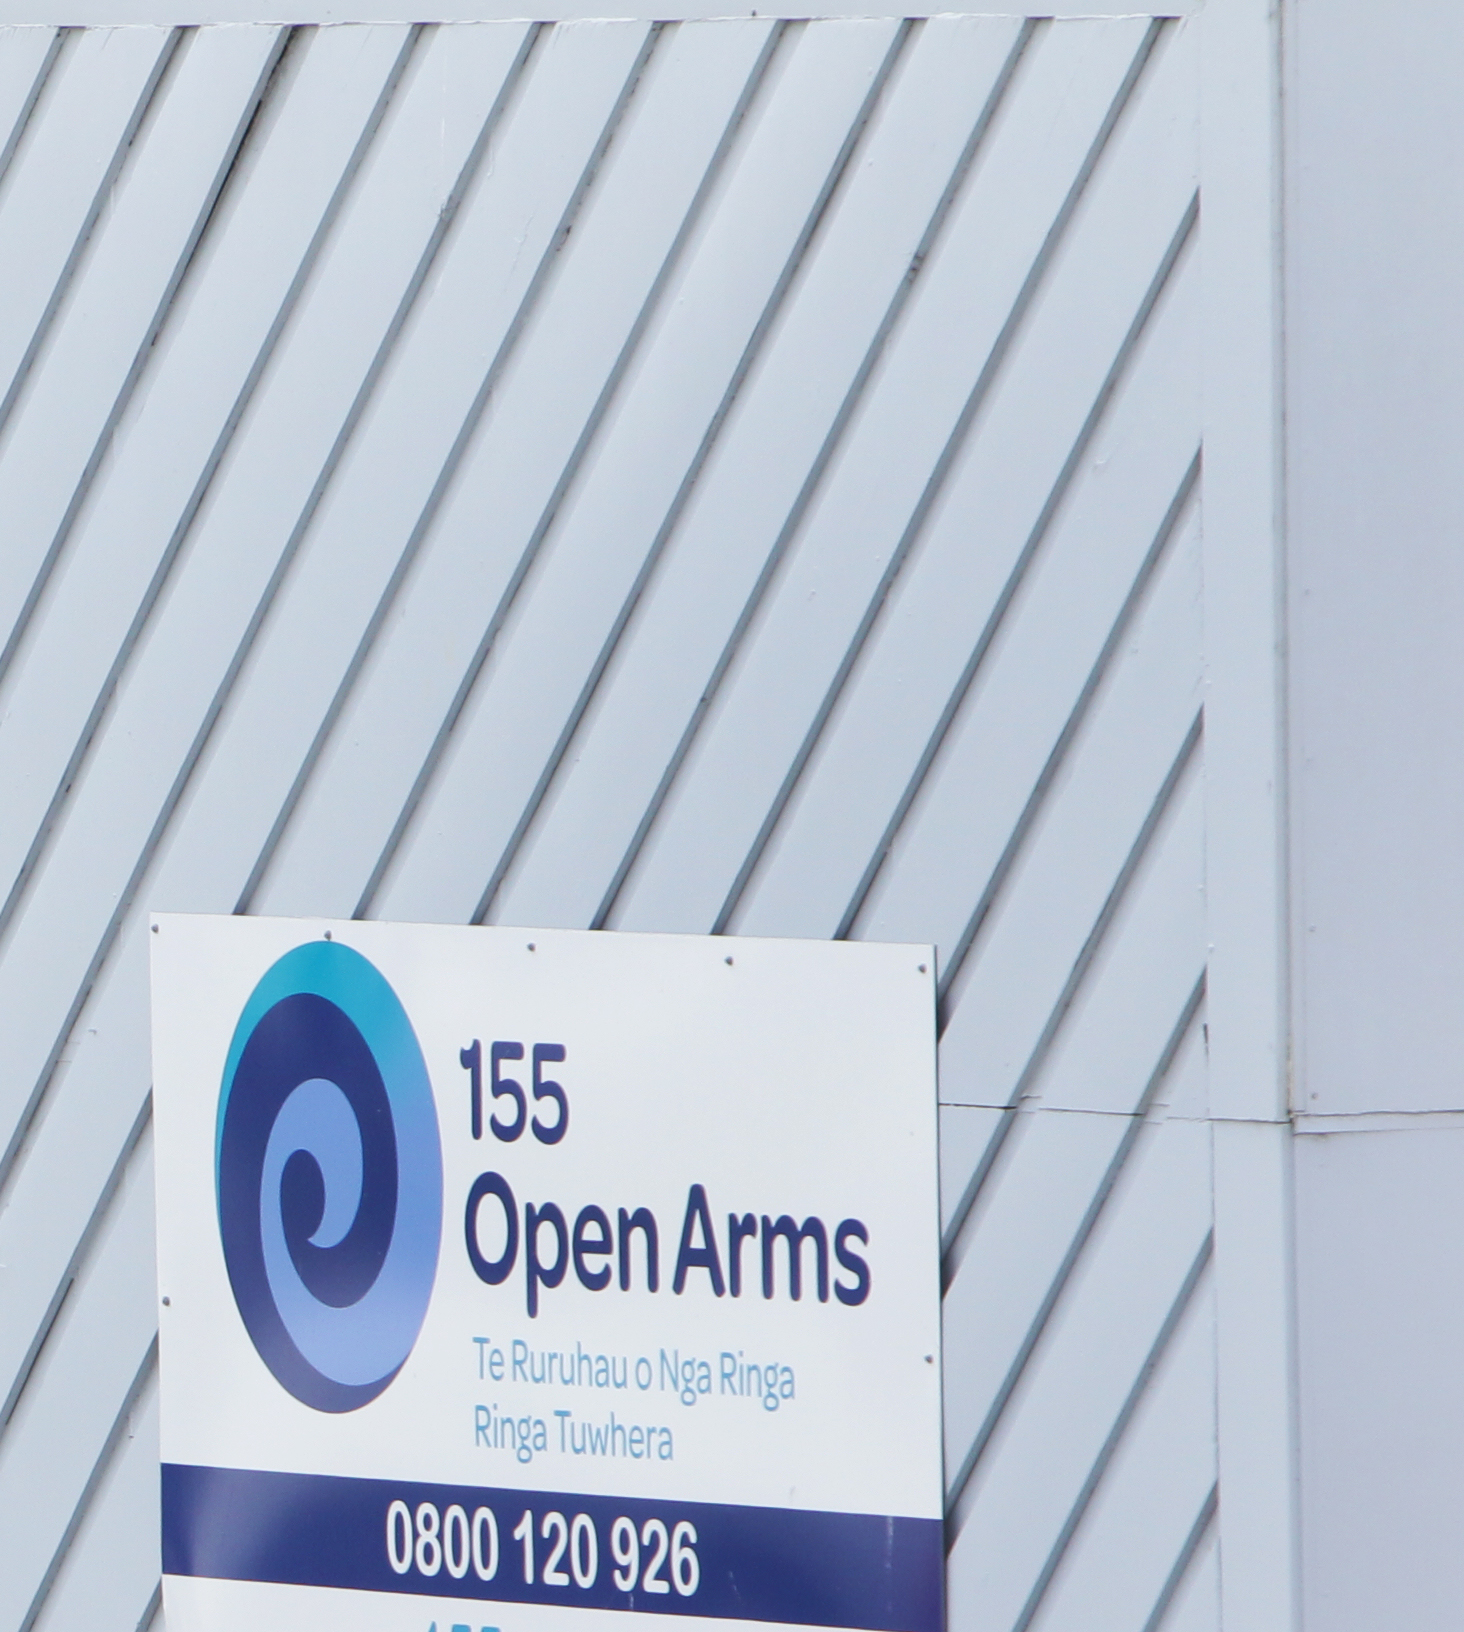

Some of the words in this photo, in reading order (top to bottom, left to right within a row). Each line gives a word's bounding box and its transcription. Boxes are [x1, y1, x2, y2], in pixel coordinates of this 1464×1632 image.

[459, 1038, 570, 1146] 155
[463, 1170, 661, 1318] Open
[671, 1183, 873, 1307] Arms
[472, 1336, 505, 1382] Te
[511, 1338, 628, 1390] Ruruhau
[634, 1356, 653, 1391] o
[659, 1347, 712, 1407] Nga
[719, 1350, 797, 1412] Ringa
[474, 1402, 548, 1464] Ringa
[553, 1409, 674, 1461] Tuwhera
[385, 1499, 500, 1582] 0800
[513, 1508, 599, 1590] 120
[610, 1515, 701, 1597] 926
